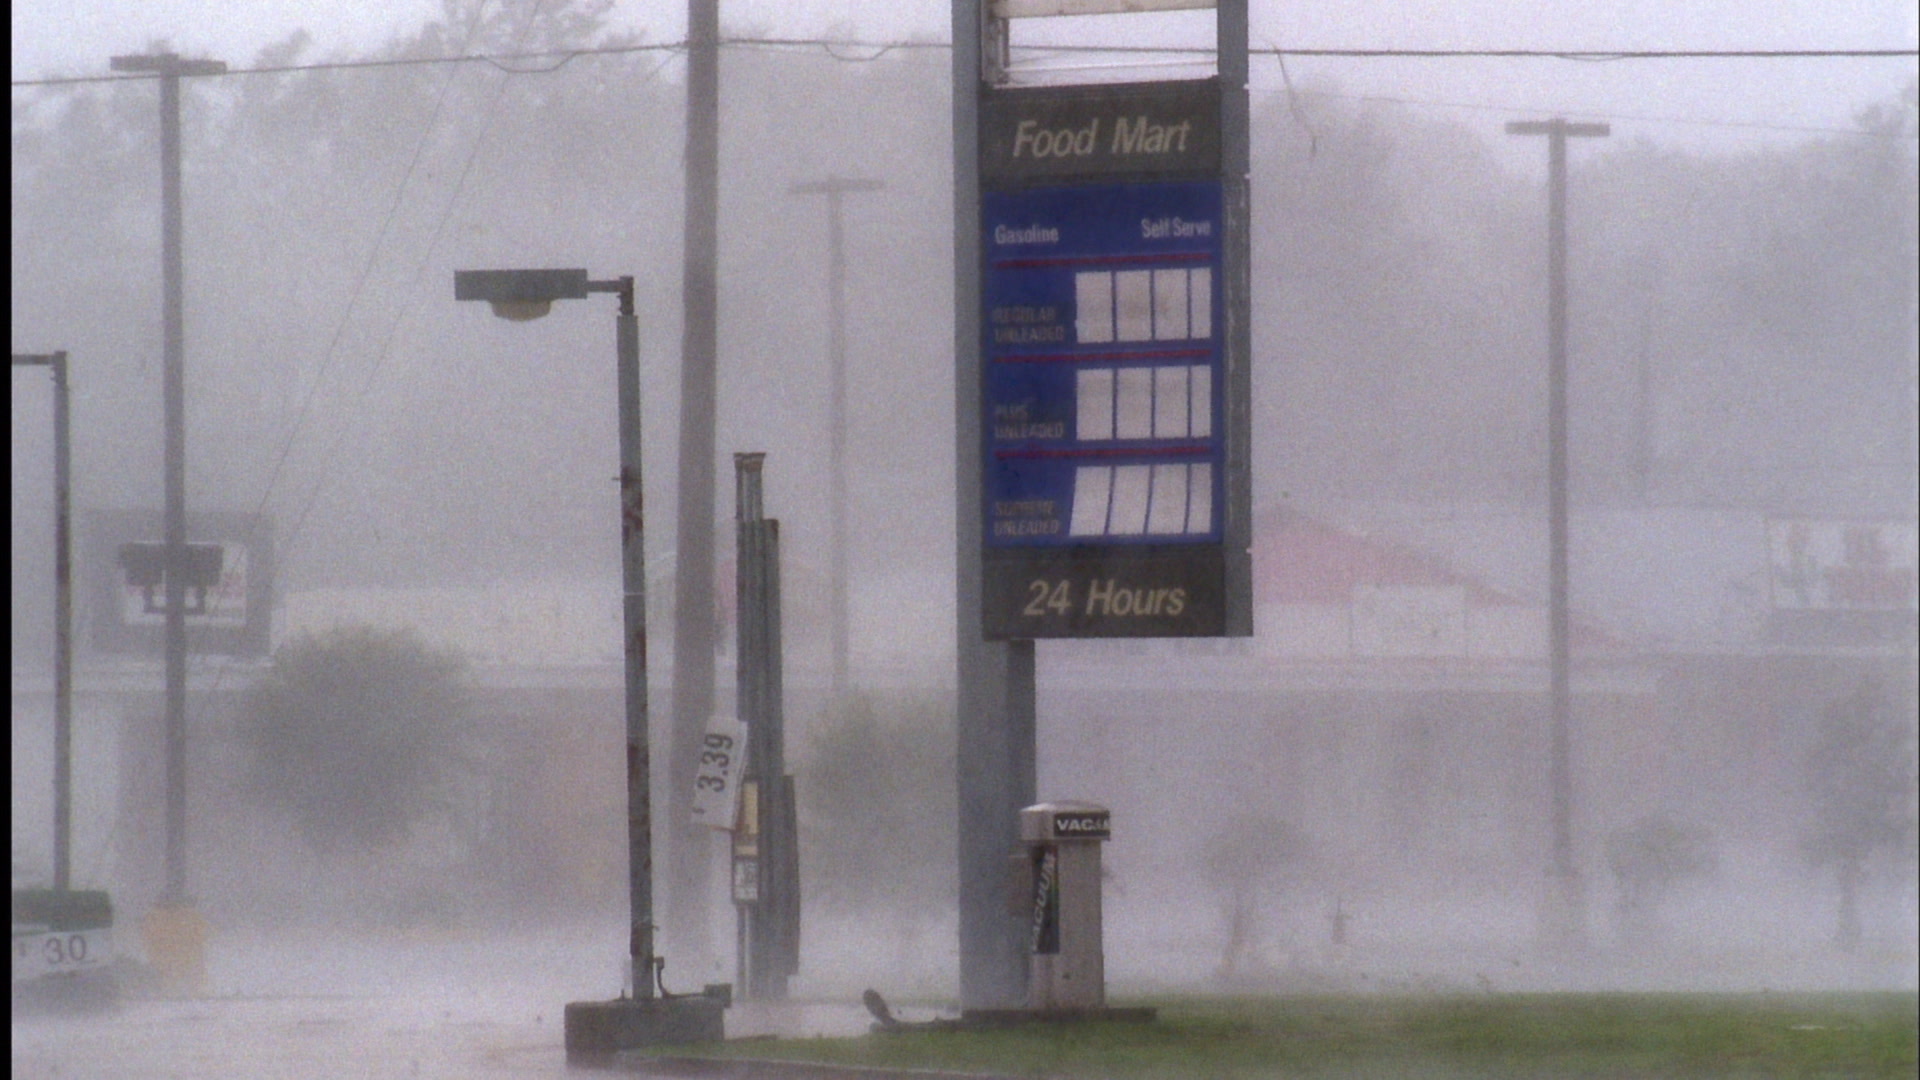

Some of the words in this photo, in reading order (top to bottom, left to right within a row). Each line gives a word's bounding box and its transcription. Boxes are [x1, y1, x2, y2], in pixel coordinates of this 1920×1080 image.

[1013, 117, 1100, 158] Food
[1111, 115, 1191, 154] Mart
[994, 223, 1060, 246] Gasoline
[1141, 217, 1171, 239] Self
[1173, 216, 1211, 237] Serve
[993, 325, 1065, 343] UNLEADED
[993, 422, 1065, 439] UNLEADED
[993, 519, 1062, 537] UNLEADED
[1022, 579, 1073, 617] 24
[1085, 578, 1187, 617] Hours
[697, 733, 734, 793] 3.39
